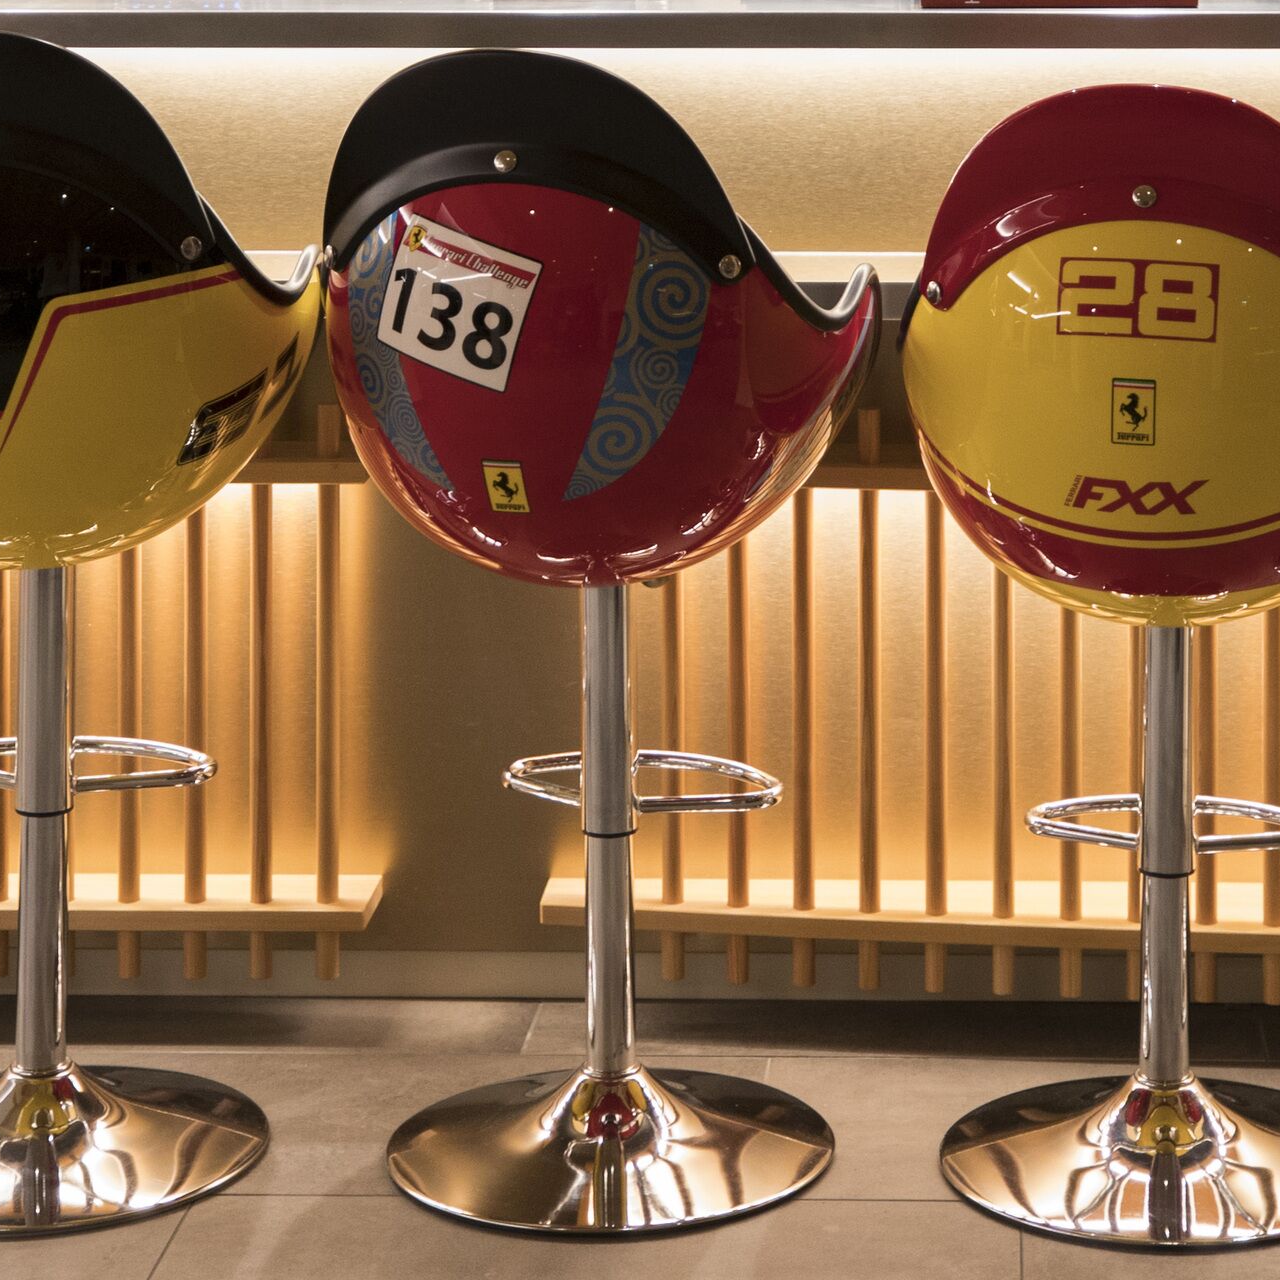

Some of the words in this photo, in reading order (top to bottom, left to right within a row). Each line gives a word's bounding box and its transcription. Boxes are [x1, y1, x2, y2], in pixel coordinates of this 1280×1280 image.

[466, 253, 530, 289] Challenge
[392, 267, 514, 371] 138
[1059, 259, 1216, 340] 28
[1064, 474, 1083, 507] FERRARI
[1072, 476, 1211, 516] FXX
